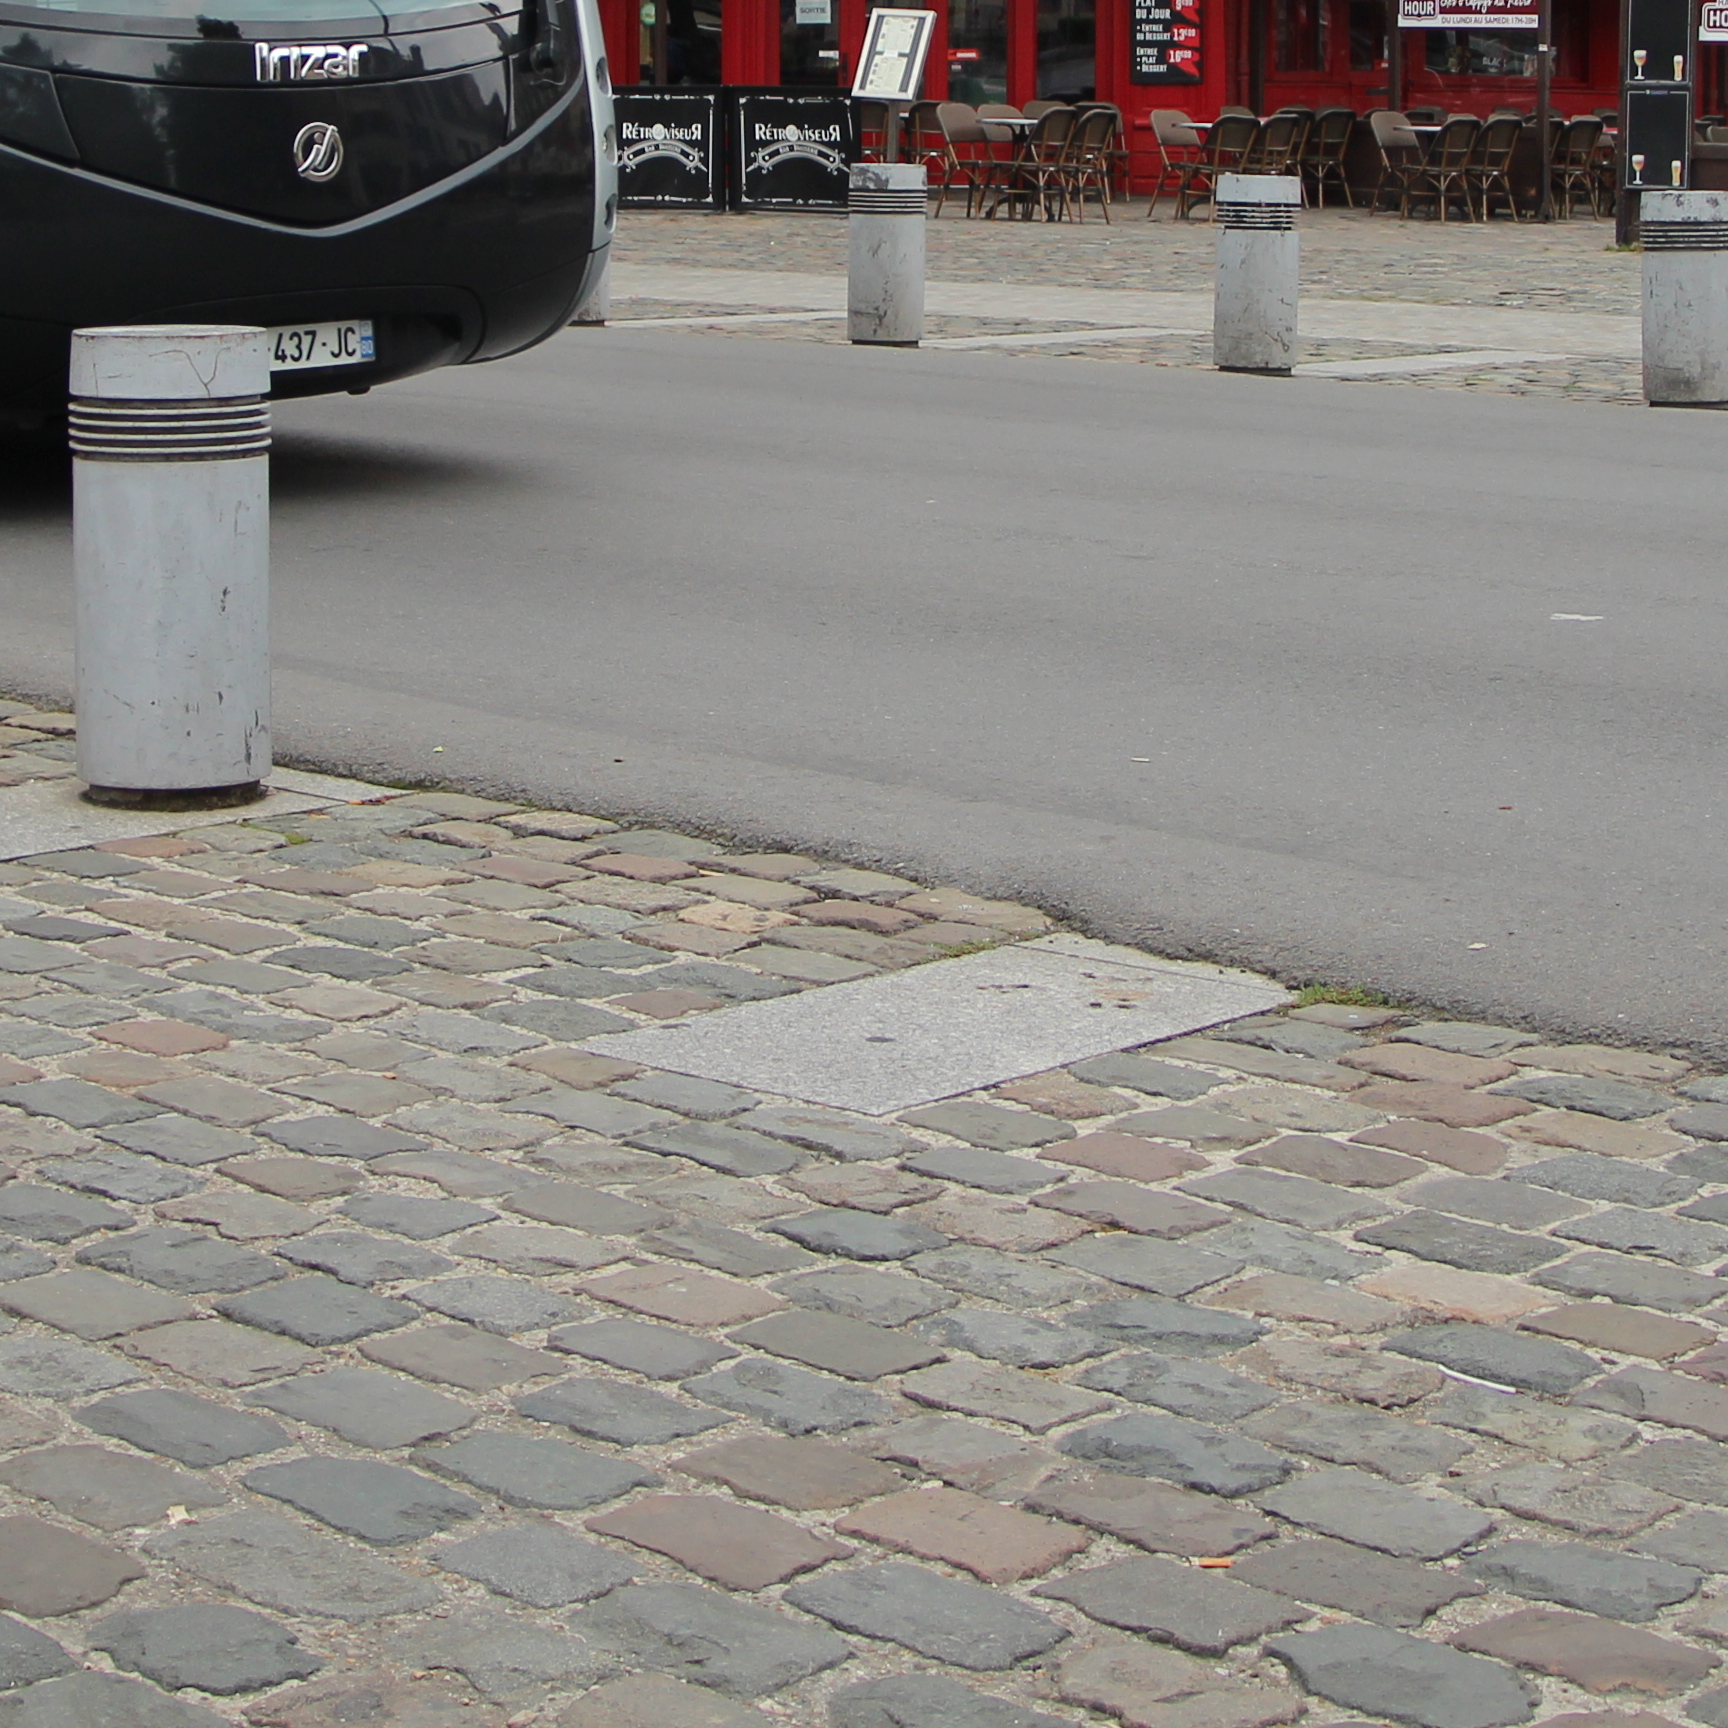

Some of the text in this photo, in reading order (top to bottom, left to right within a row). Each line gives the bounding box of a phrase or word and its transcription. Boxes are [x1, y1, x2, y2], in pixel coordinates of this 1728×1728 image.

[799, 6, 827, 15] SORTIE
[1135, 7, 1172, 19] DU JOUR
[1404, 1, 1434, 15] HOUR
